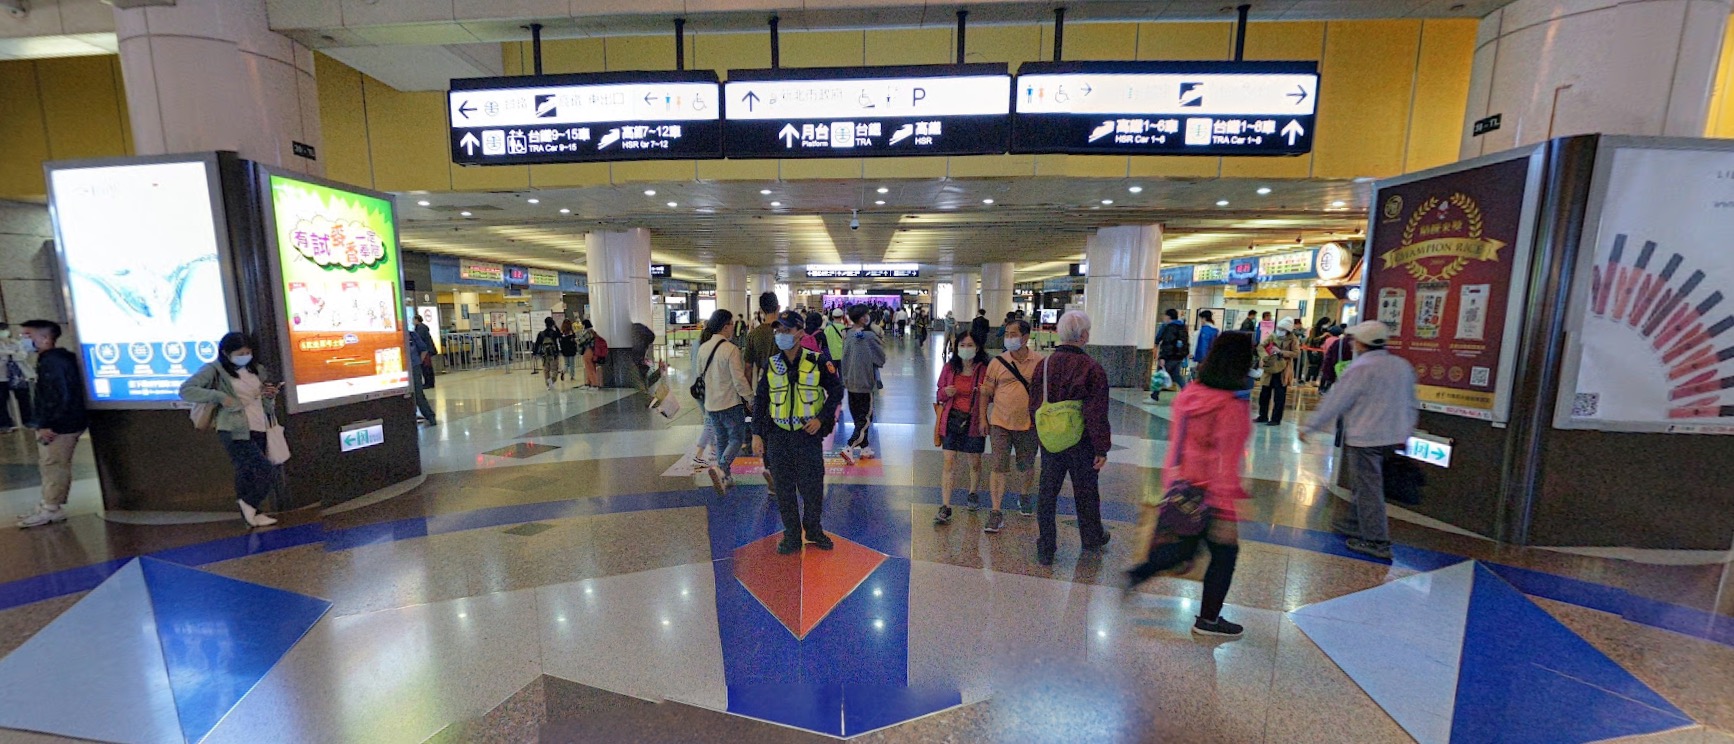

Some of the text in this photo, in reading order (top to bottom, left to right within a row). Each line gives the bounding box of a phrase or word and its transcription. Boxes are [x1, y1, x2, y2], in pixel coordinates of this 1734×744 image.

[912, 87, 926, 107] P
[802, 122, 829, 140] 月台
[856, 138, 872, 146] TRA
[915, 137, 933, 145] HSR
[1115, 135, 1133, 144] HSR
[1135, 135, 1150, 144] Car
[1212, 135, 1230, 145] TRA
[1231, 136, 1246, 145] Car
[529, 144, 544, 152] TRA
[545, 144, 559, 152] Car
[622, 141, 639, 149] HSR
[1394, 243, 1485, 263] CHAMPION RICE
